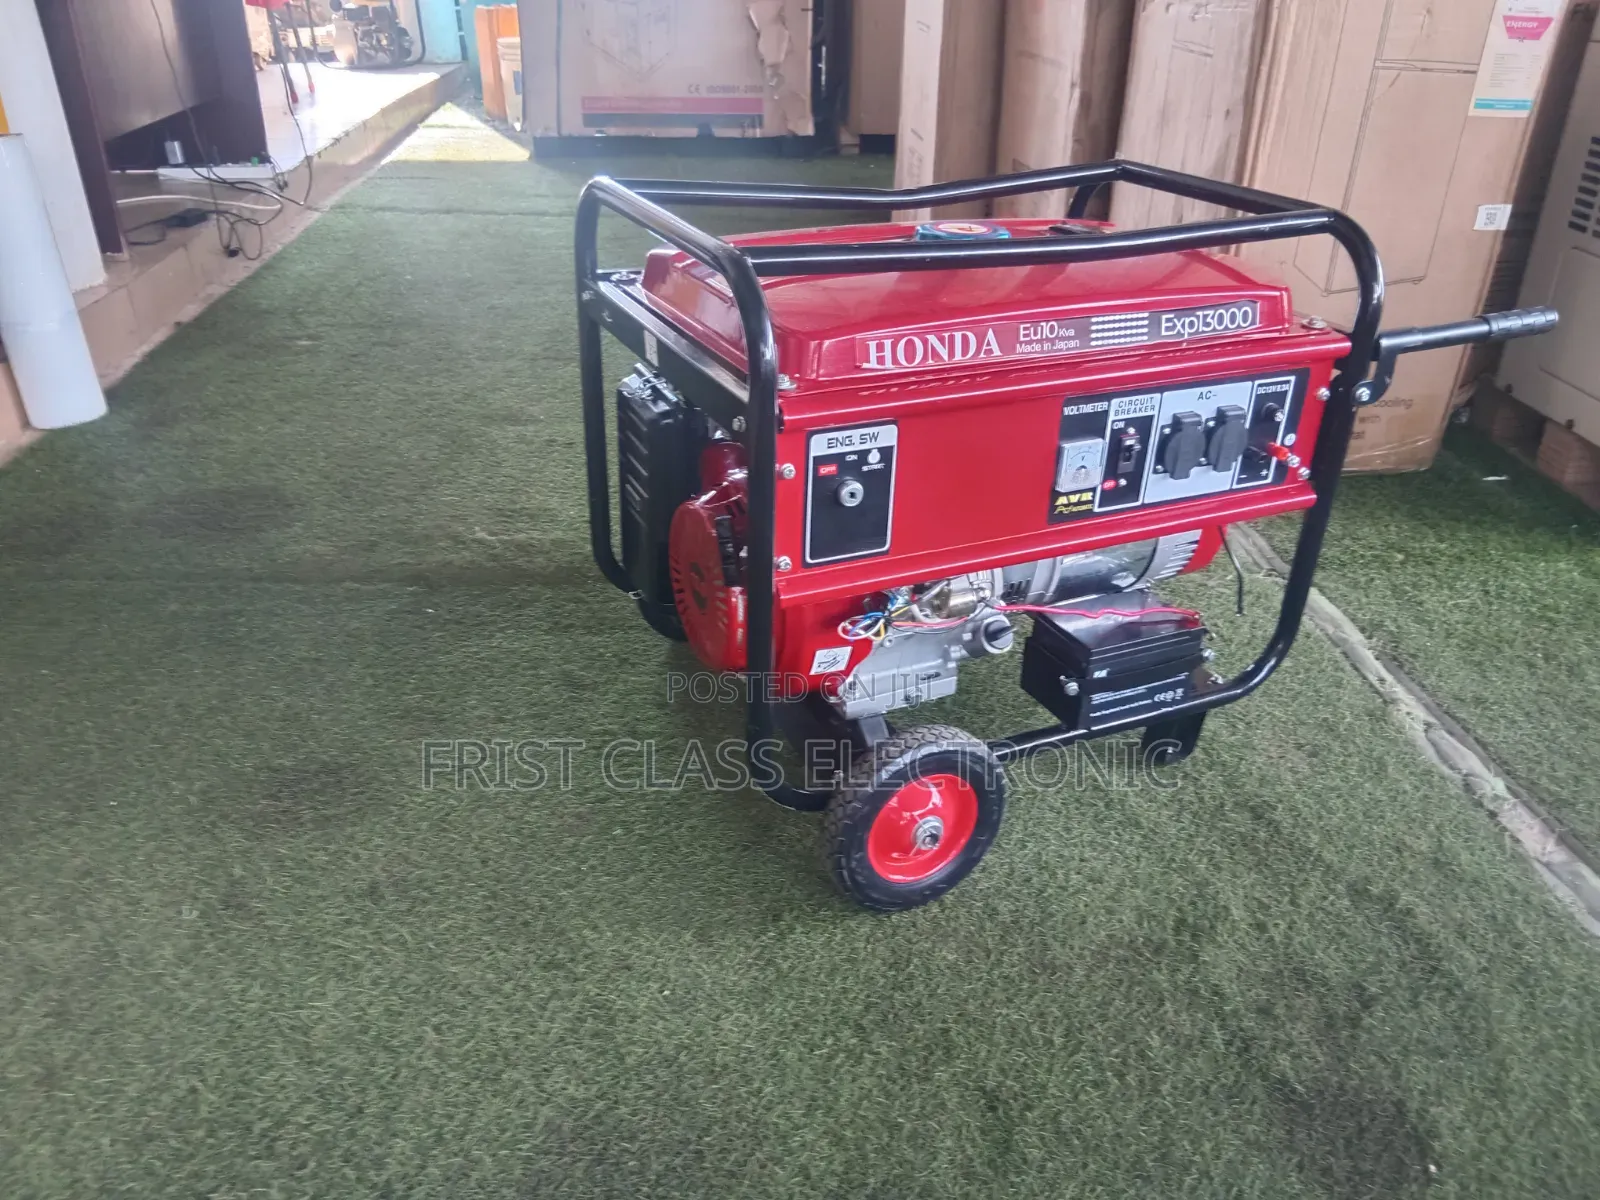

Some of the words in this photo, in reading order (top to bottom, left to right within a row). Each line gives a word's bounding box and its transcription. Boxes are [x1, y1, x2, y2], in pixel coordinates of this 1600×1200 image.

[1161, 306, 1252, 339] Exp13000
[1020, 321, 1058, 341] Eu10
[1059, 328, 1075, 337] Kva
[861, 328, 1003, 369] HONDA
[1016, 342, 1042, 354] Made
[1043, 340, 1051, 351] in
[1053, 339, 1080, 351] Japan
[1063, 401, 1109, 416] VOLTMETER
[1118, 396, 1155, 409] CIRCUIT
[1114, 404, 1156, 417] BREAKER
[1112, 420, 1125, 430] ON
[827, 435, 855, 449] ENG.
[859, 431, 880, 445] SW
